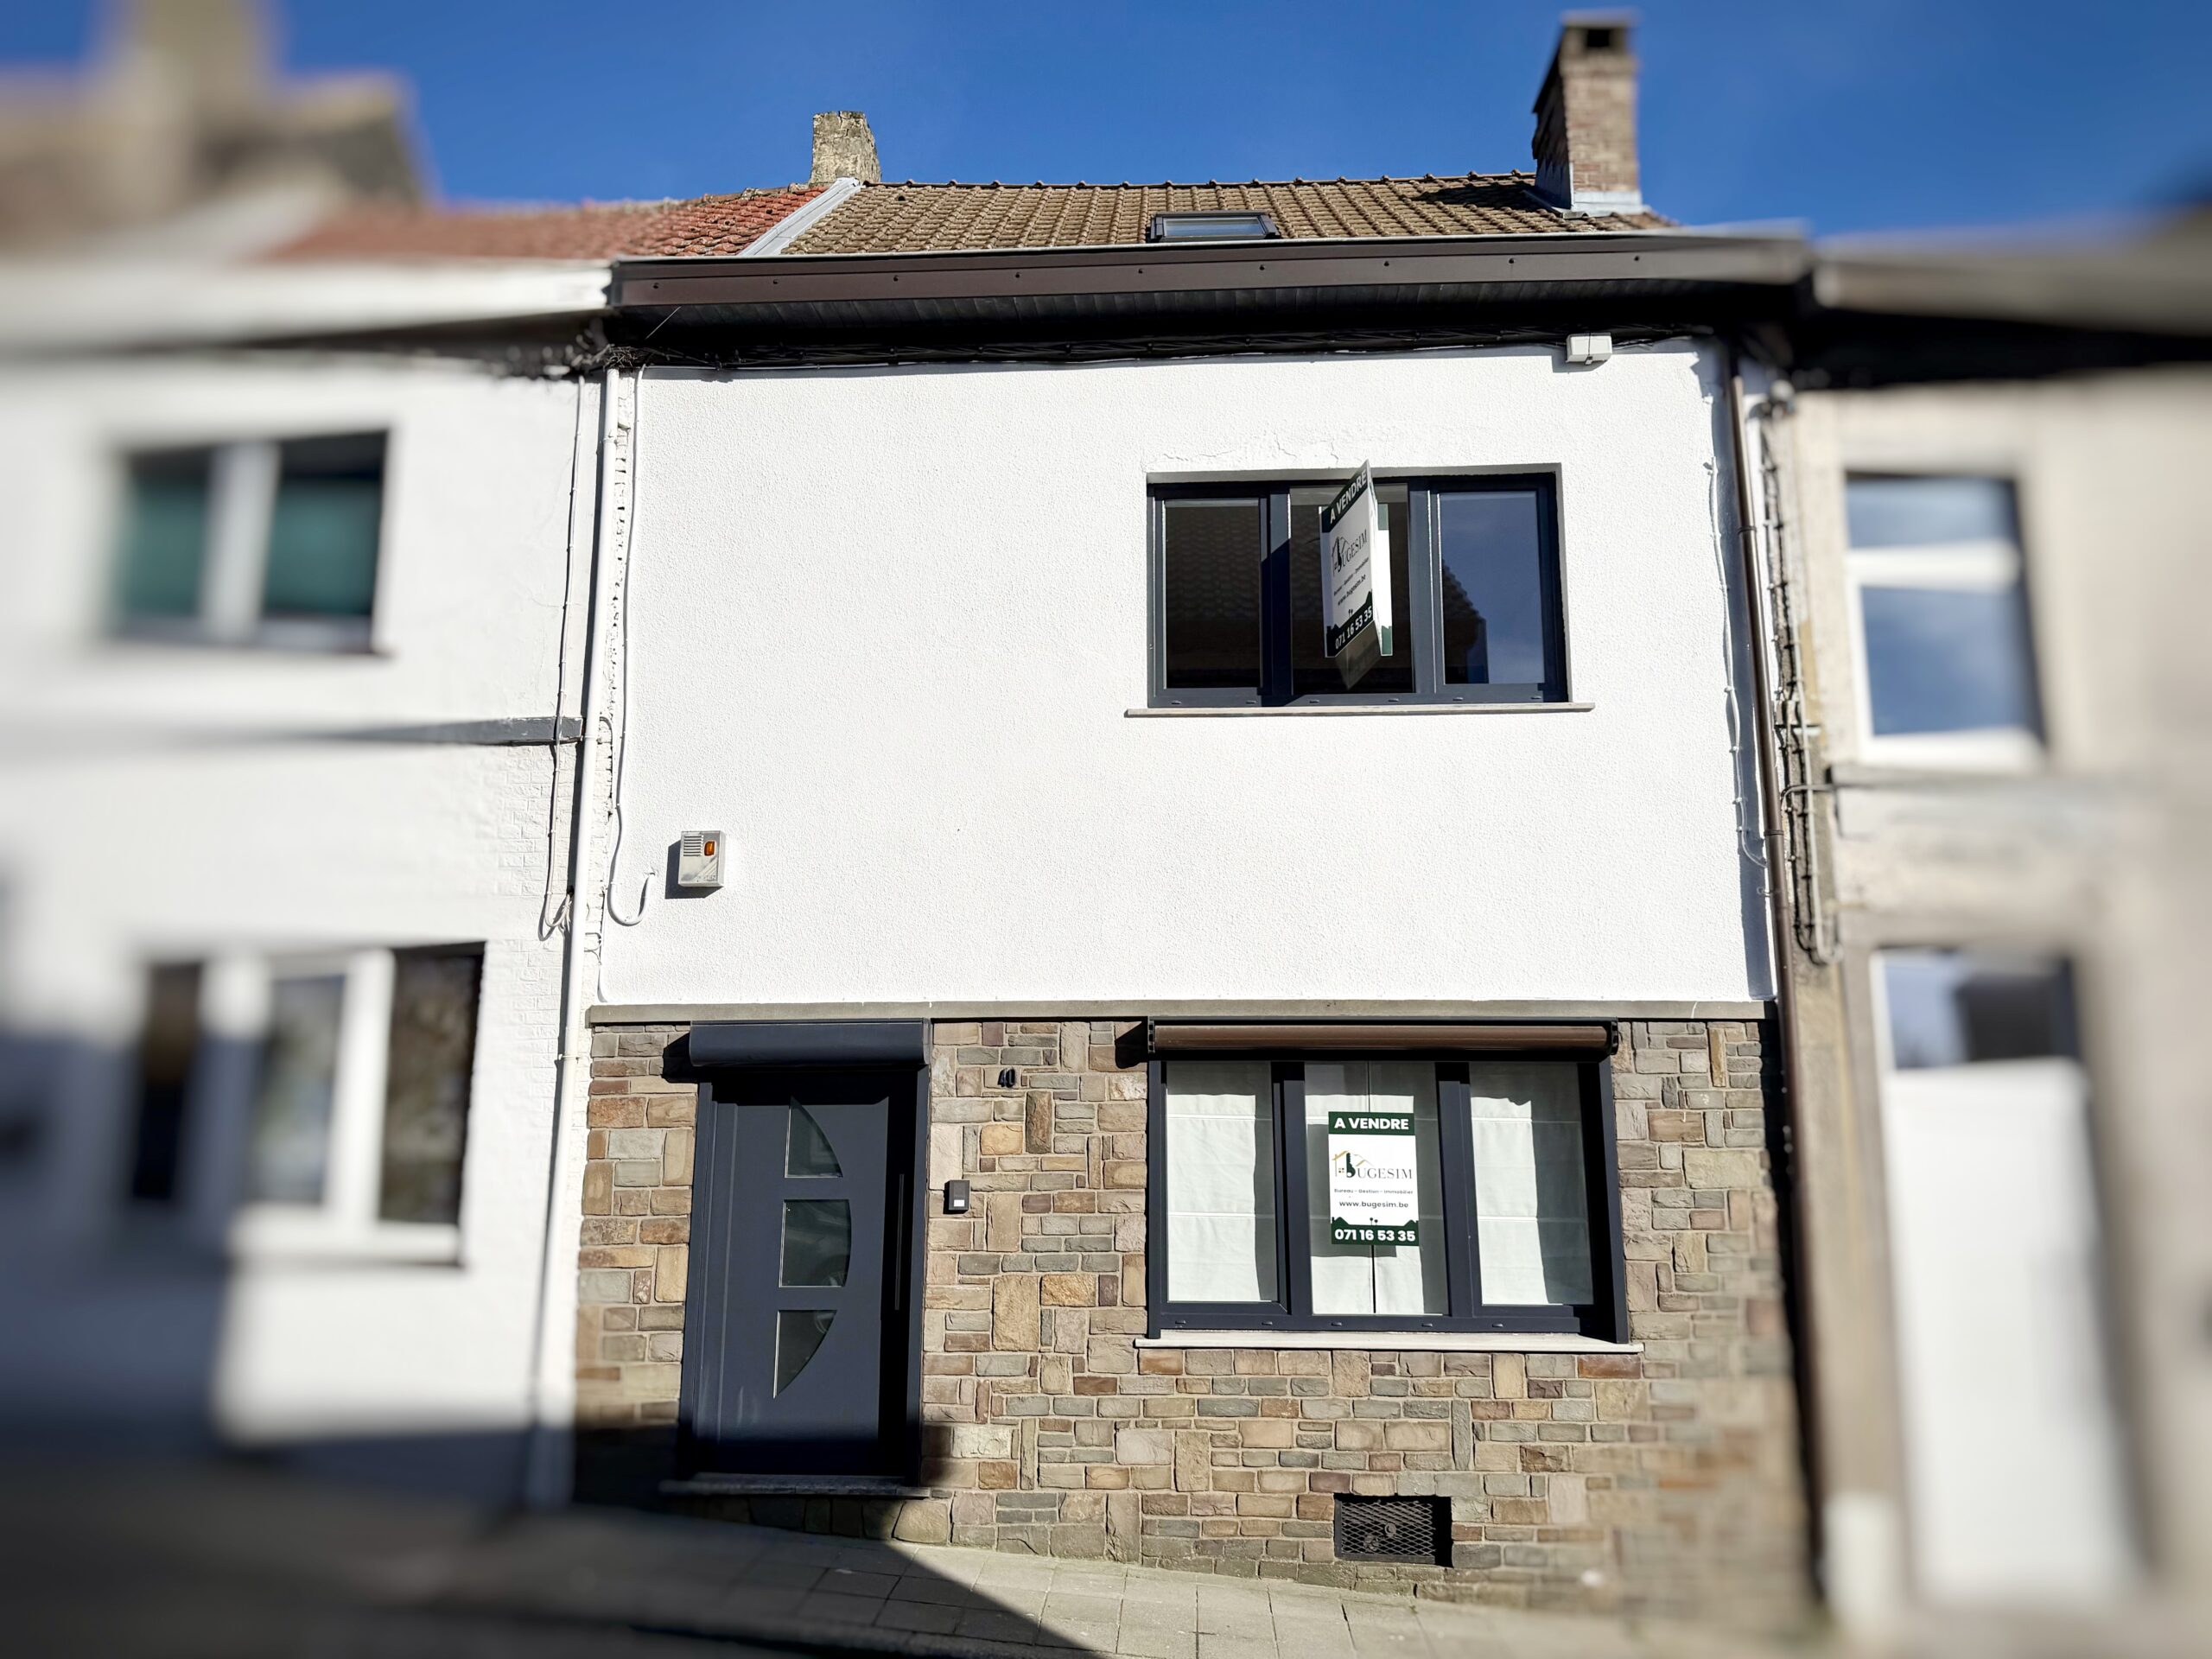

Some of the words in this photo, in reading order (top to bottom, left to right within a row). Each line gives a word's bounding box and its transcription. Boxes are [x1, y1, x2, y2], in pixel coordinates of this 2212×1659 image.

[1330, 508, 1336, 524] A
[1337, 469, 1367, 514] VENDRE
[1335, 632, 1345, 650] 071
[1346, 623, 1354, 639] 16
[1355, 614, 1363, 631] 53
[1363, 605, 1372, 622] 35
[1334, 1117, 1345, 1128] A
[1348, 1117, 1409, 1130] VENDRE
[1339, 1201, 1408, 1210] www.bugesim.be
[1334, 1229, 1357, 1241] 071
[1359, 1230, 1375, 1241] 16
[1377, 1230, 1395, 1242] 53
[1398, 1230, 1416, 1242] 35
